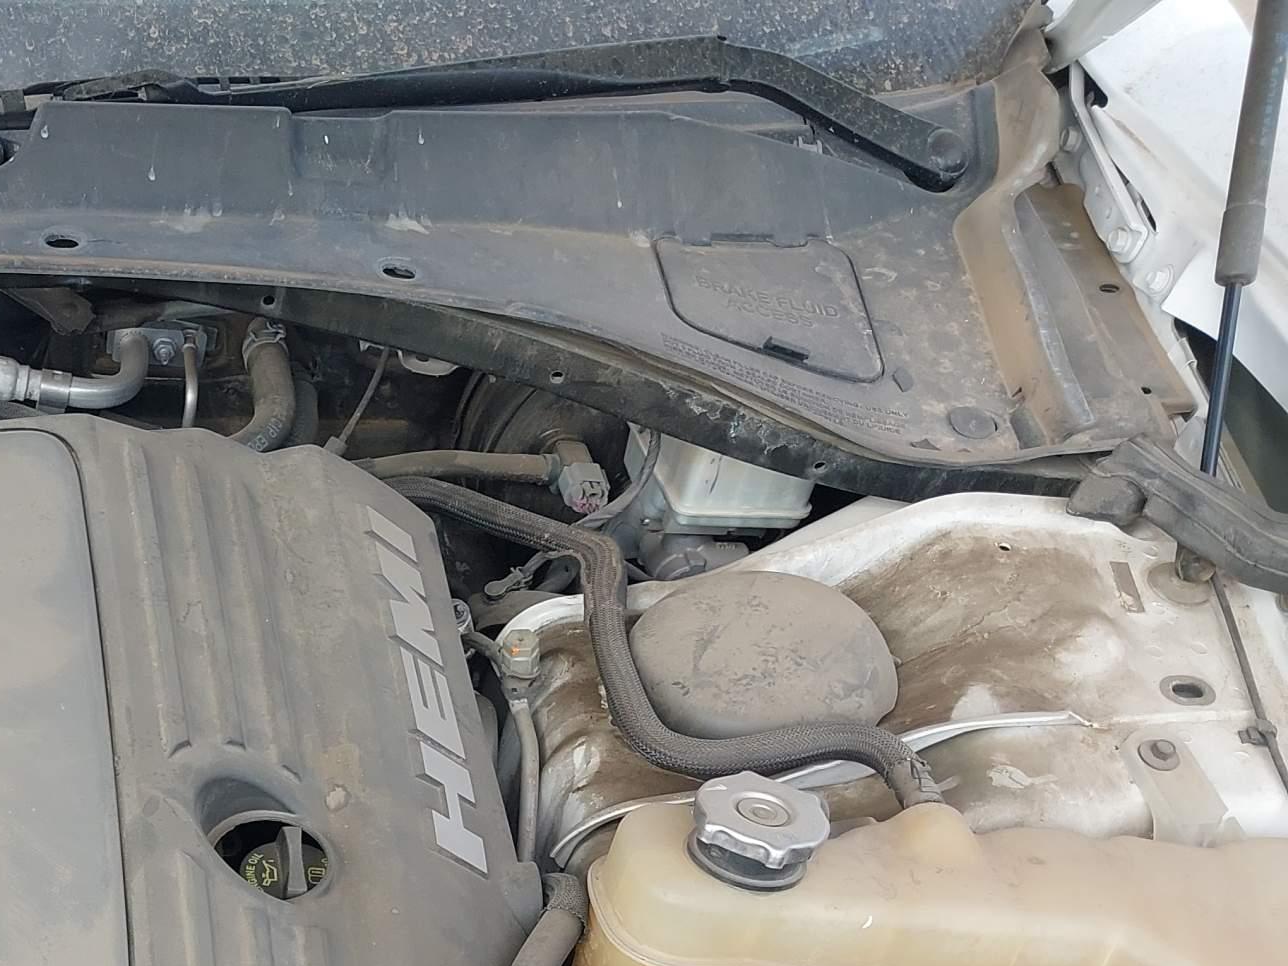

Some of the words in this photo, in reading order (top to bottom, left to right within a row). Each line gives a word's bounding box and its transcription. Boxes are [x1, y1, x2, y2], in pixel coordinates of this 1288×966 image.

[776, 296, 840, 319] FLUID
[365, 505, 488, 879] HEMI
[248, 852, 264, 865] OIL
